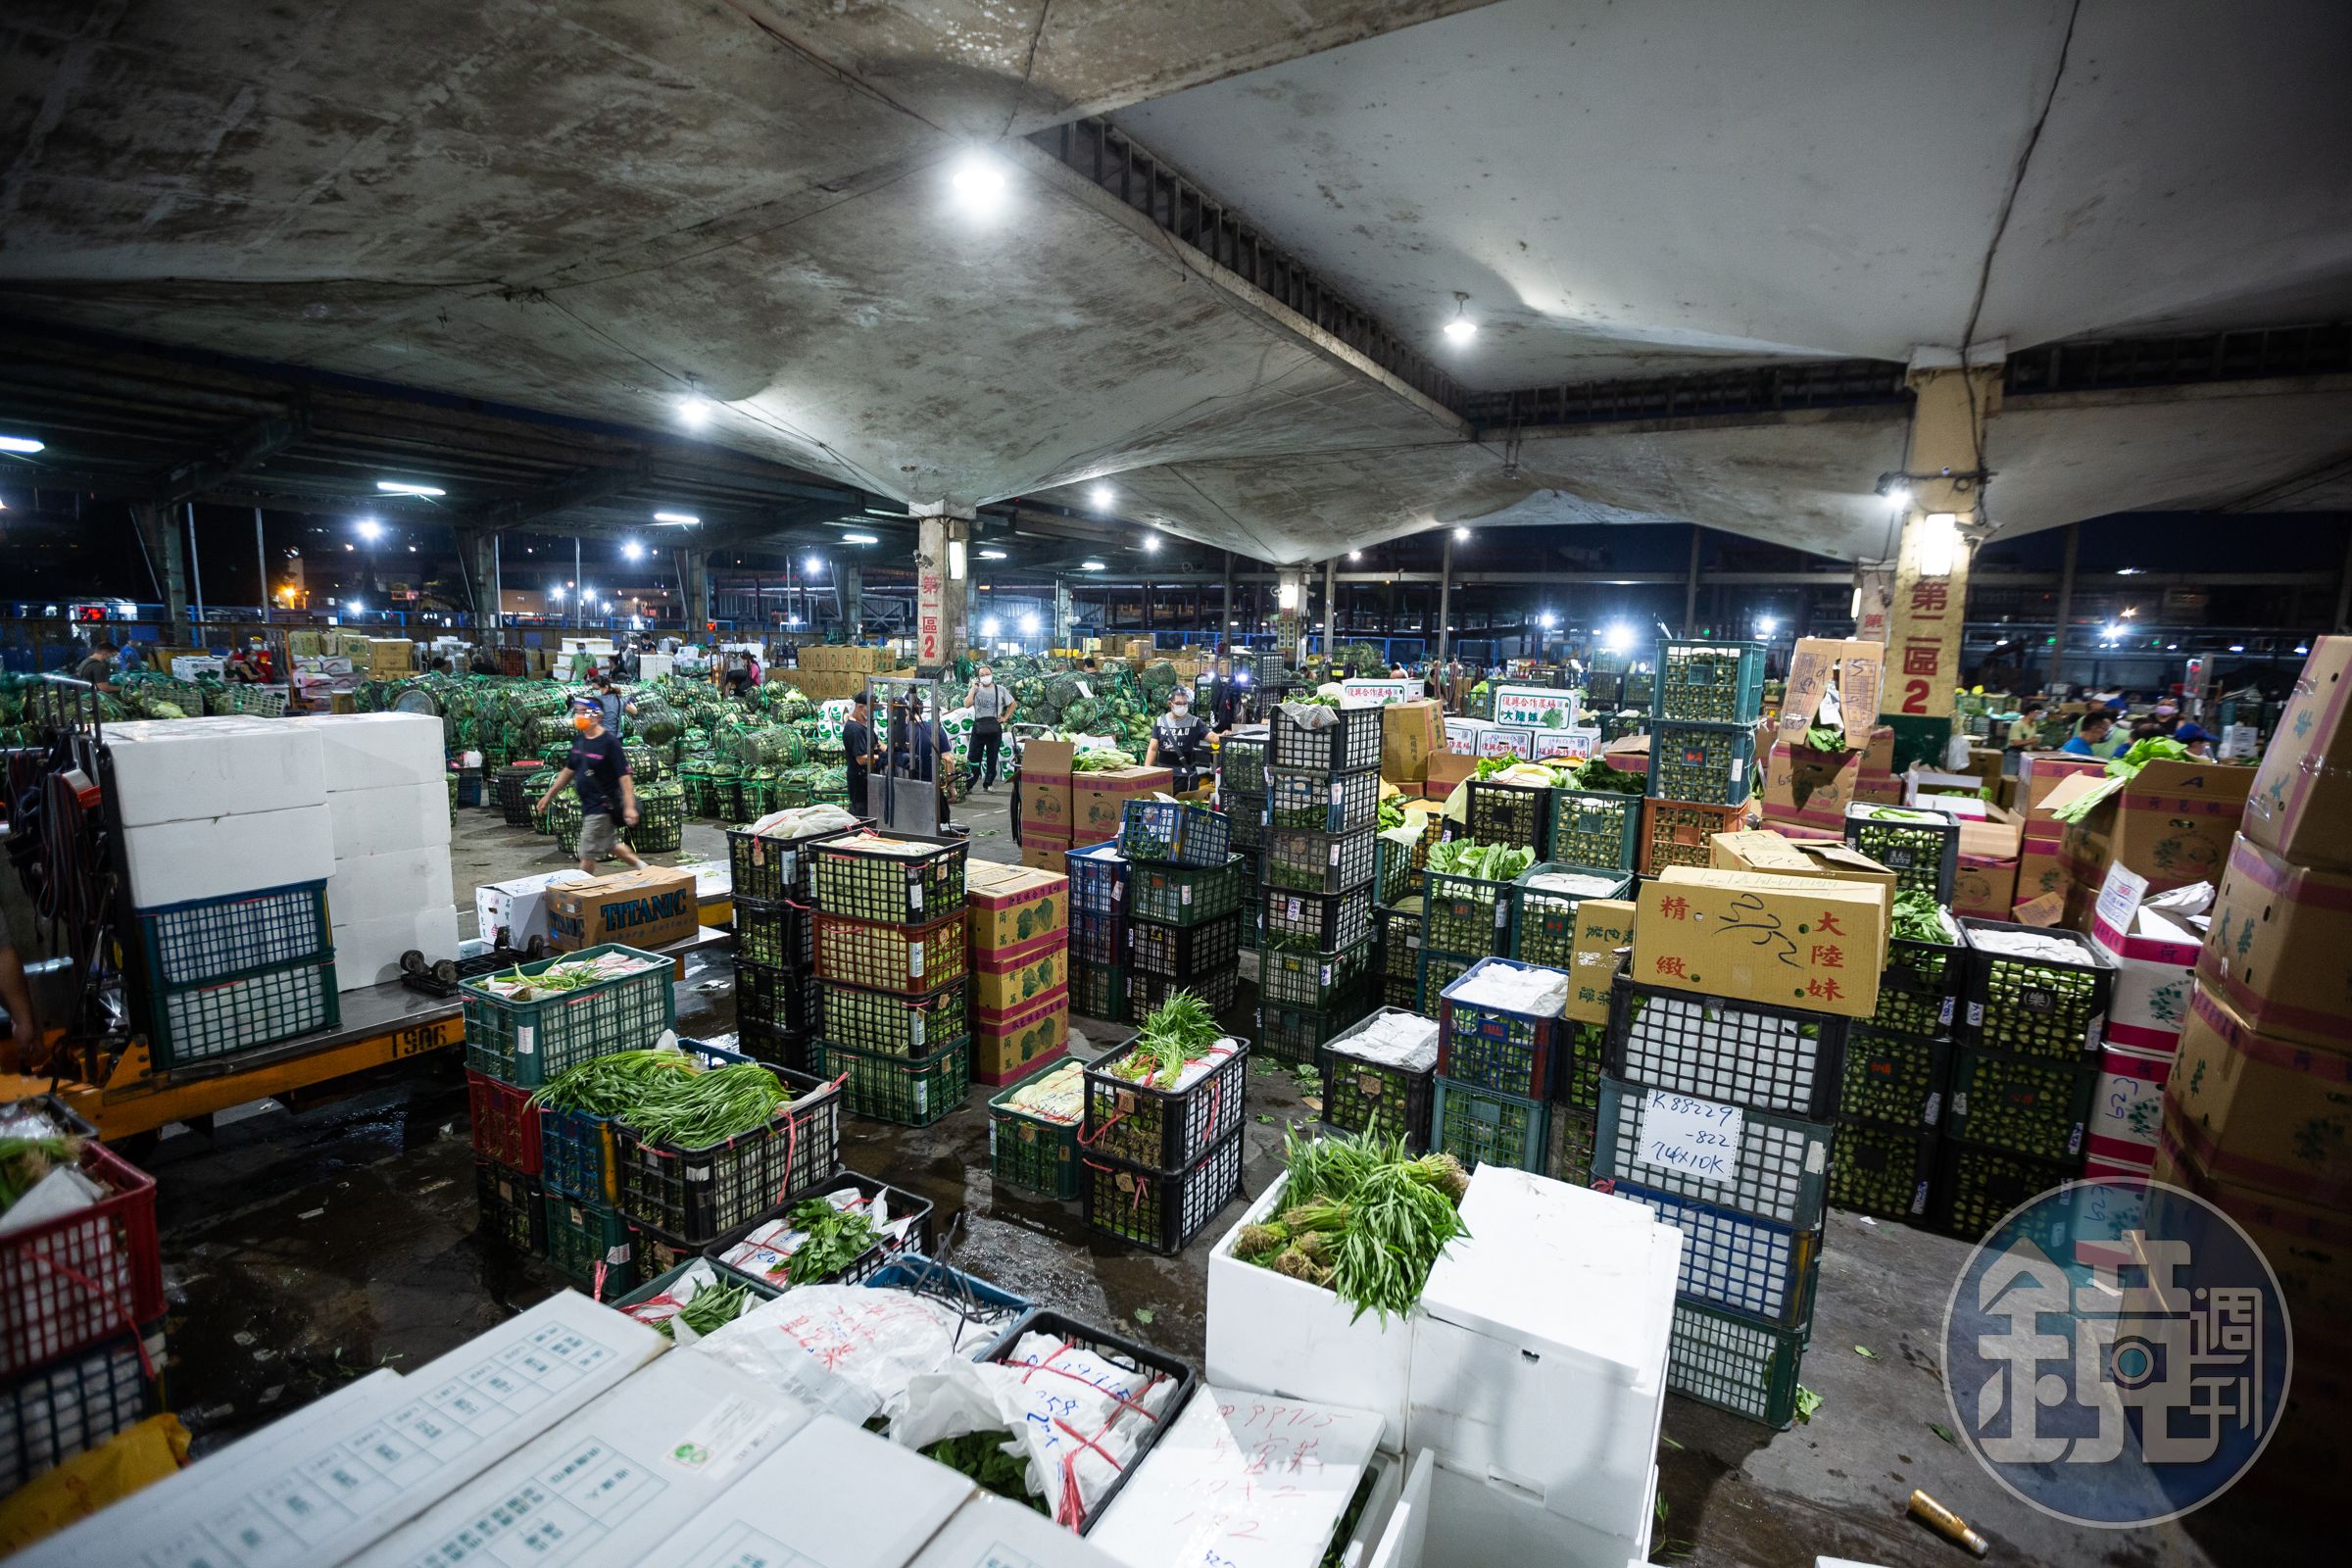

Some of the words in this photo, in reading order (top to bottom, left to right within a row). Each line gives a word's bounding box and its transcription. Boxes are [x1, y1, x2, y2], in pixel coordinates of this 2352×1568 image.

[922, 575, 939, 658] 第一區2
[1902, 580, 1949, 714] 第二區2
[1502, 697, 1556, 710] 復興合作農場
[600, 888, 687, 932] TITANIC
[1655, 895, 1690, 980] 精緻
[1806, 911, 1846, 1002] 大陸妹
